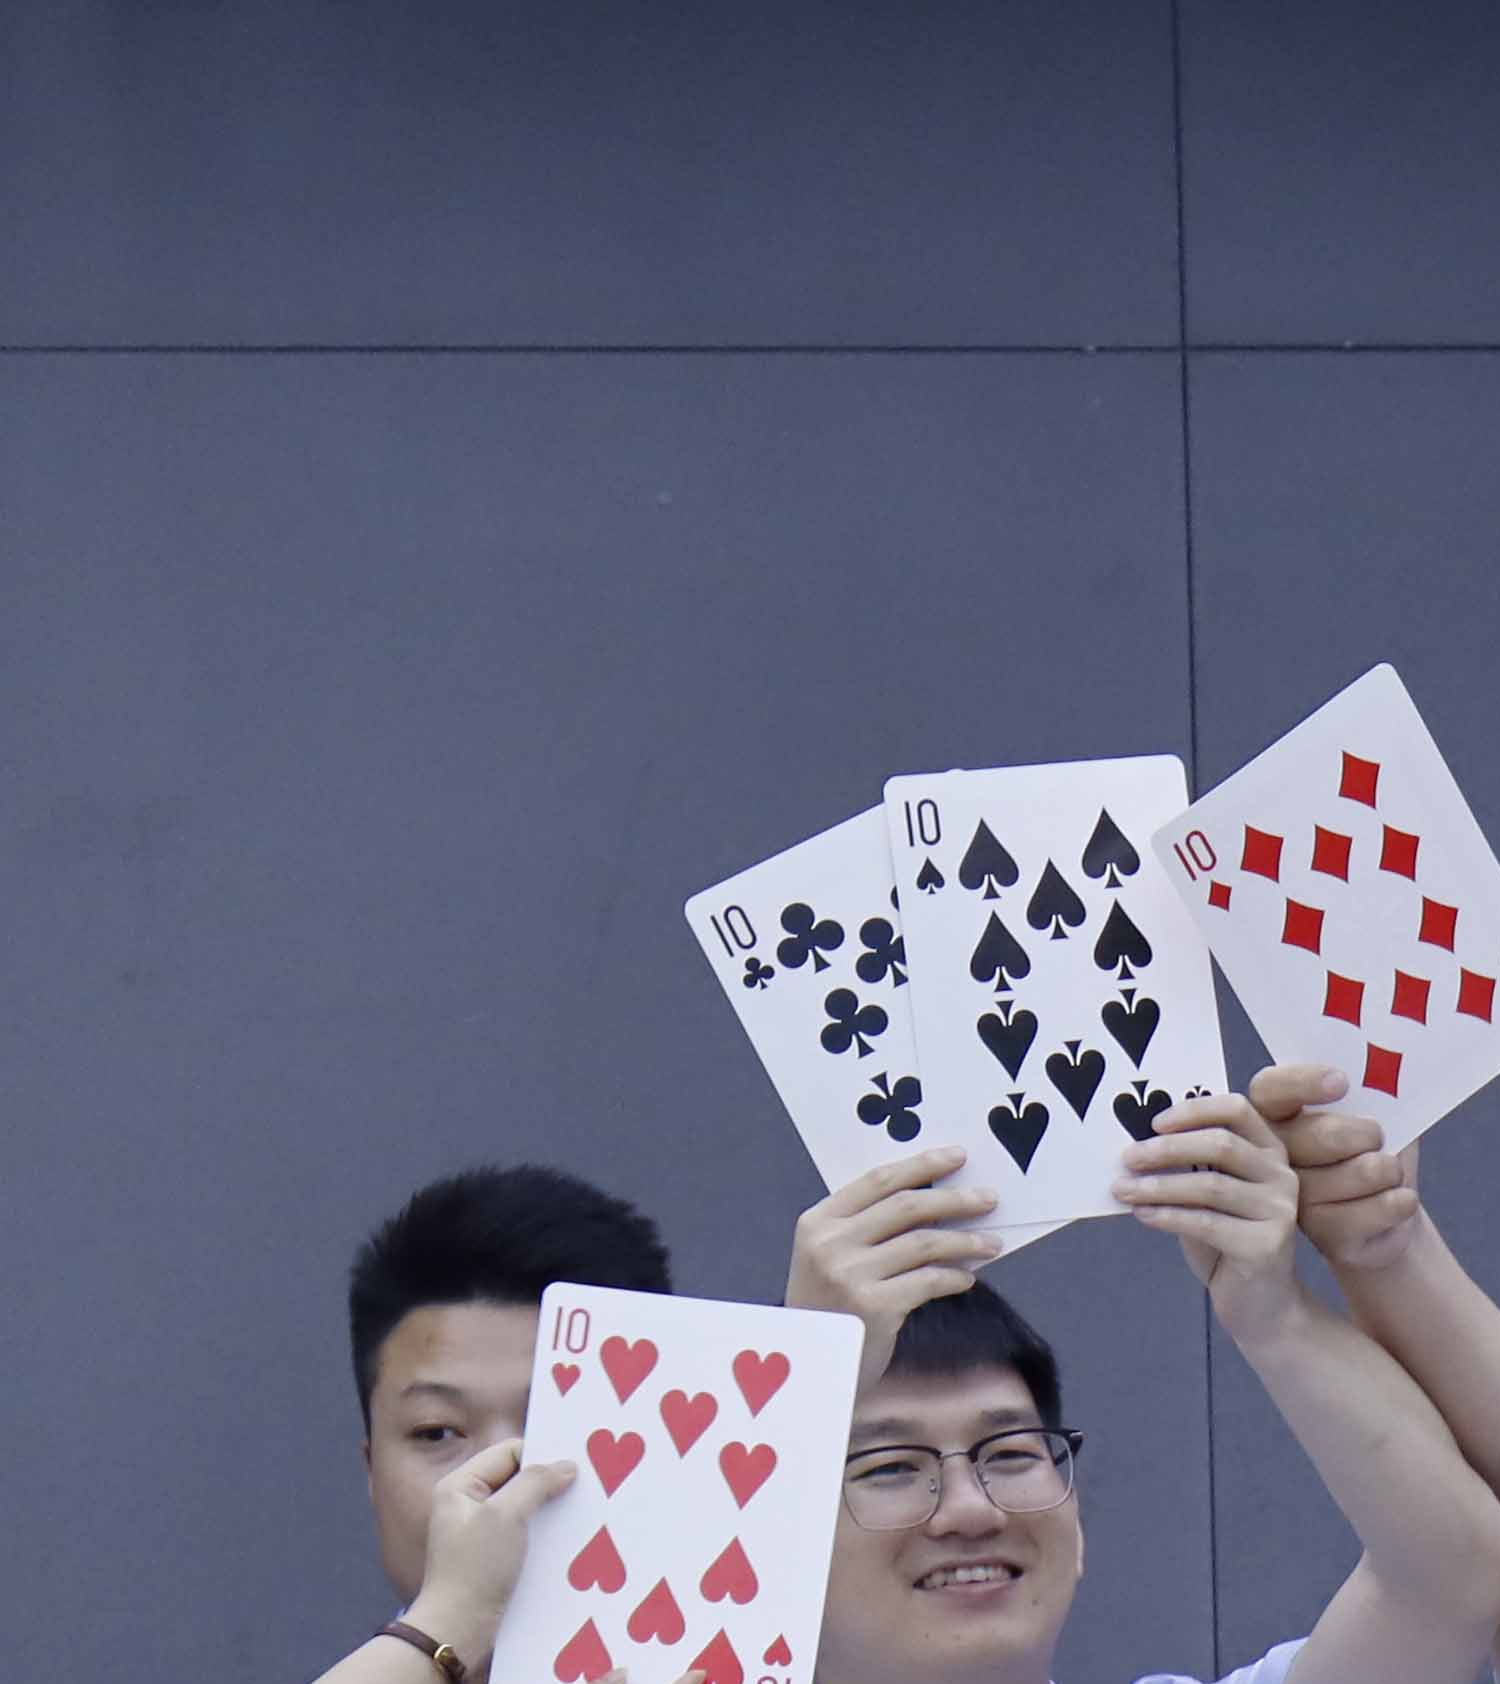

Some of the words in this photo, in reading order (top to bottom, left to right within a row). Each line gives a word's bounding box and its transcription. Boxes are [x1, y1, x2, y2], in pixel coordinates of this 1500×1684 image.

[905, 798, 942, 848] 10
[1174, 830, 1217, 882] 10
[711, 905, 758, 958] 10
[552, 1306, 591, 1355] 10
